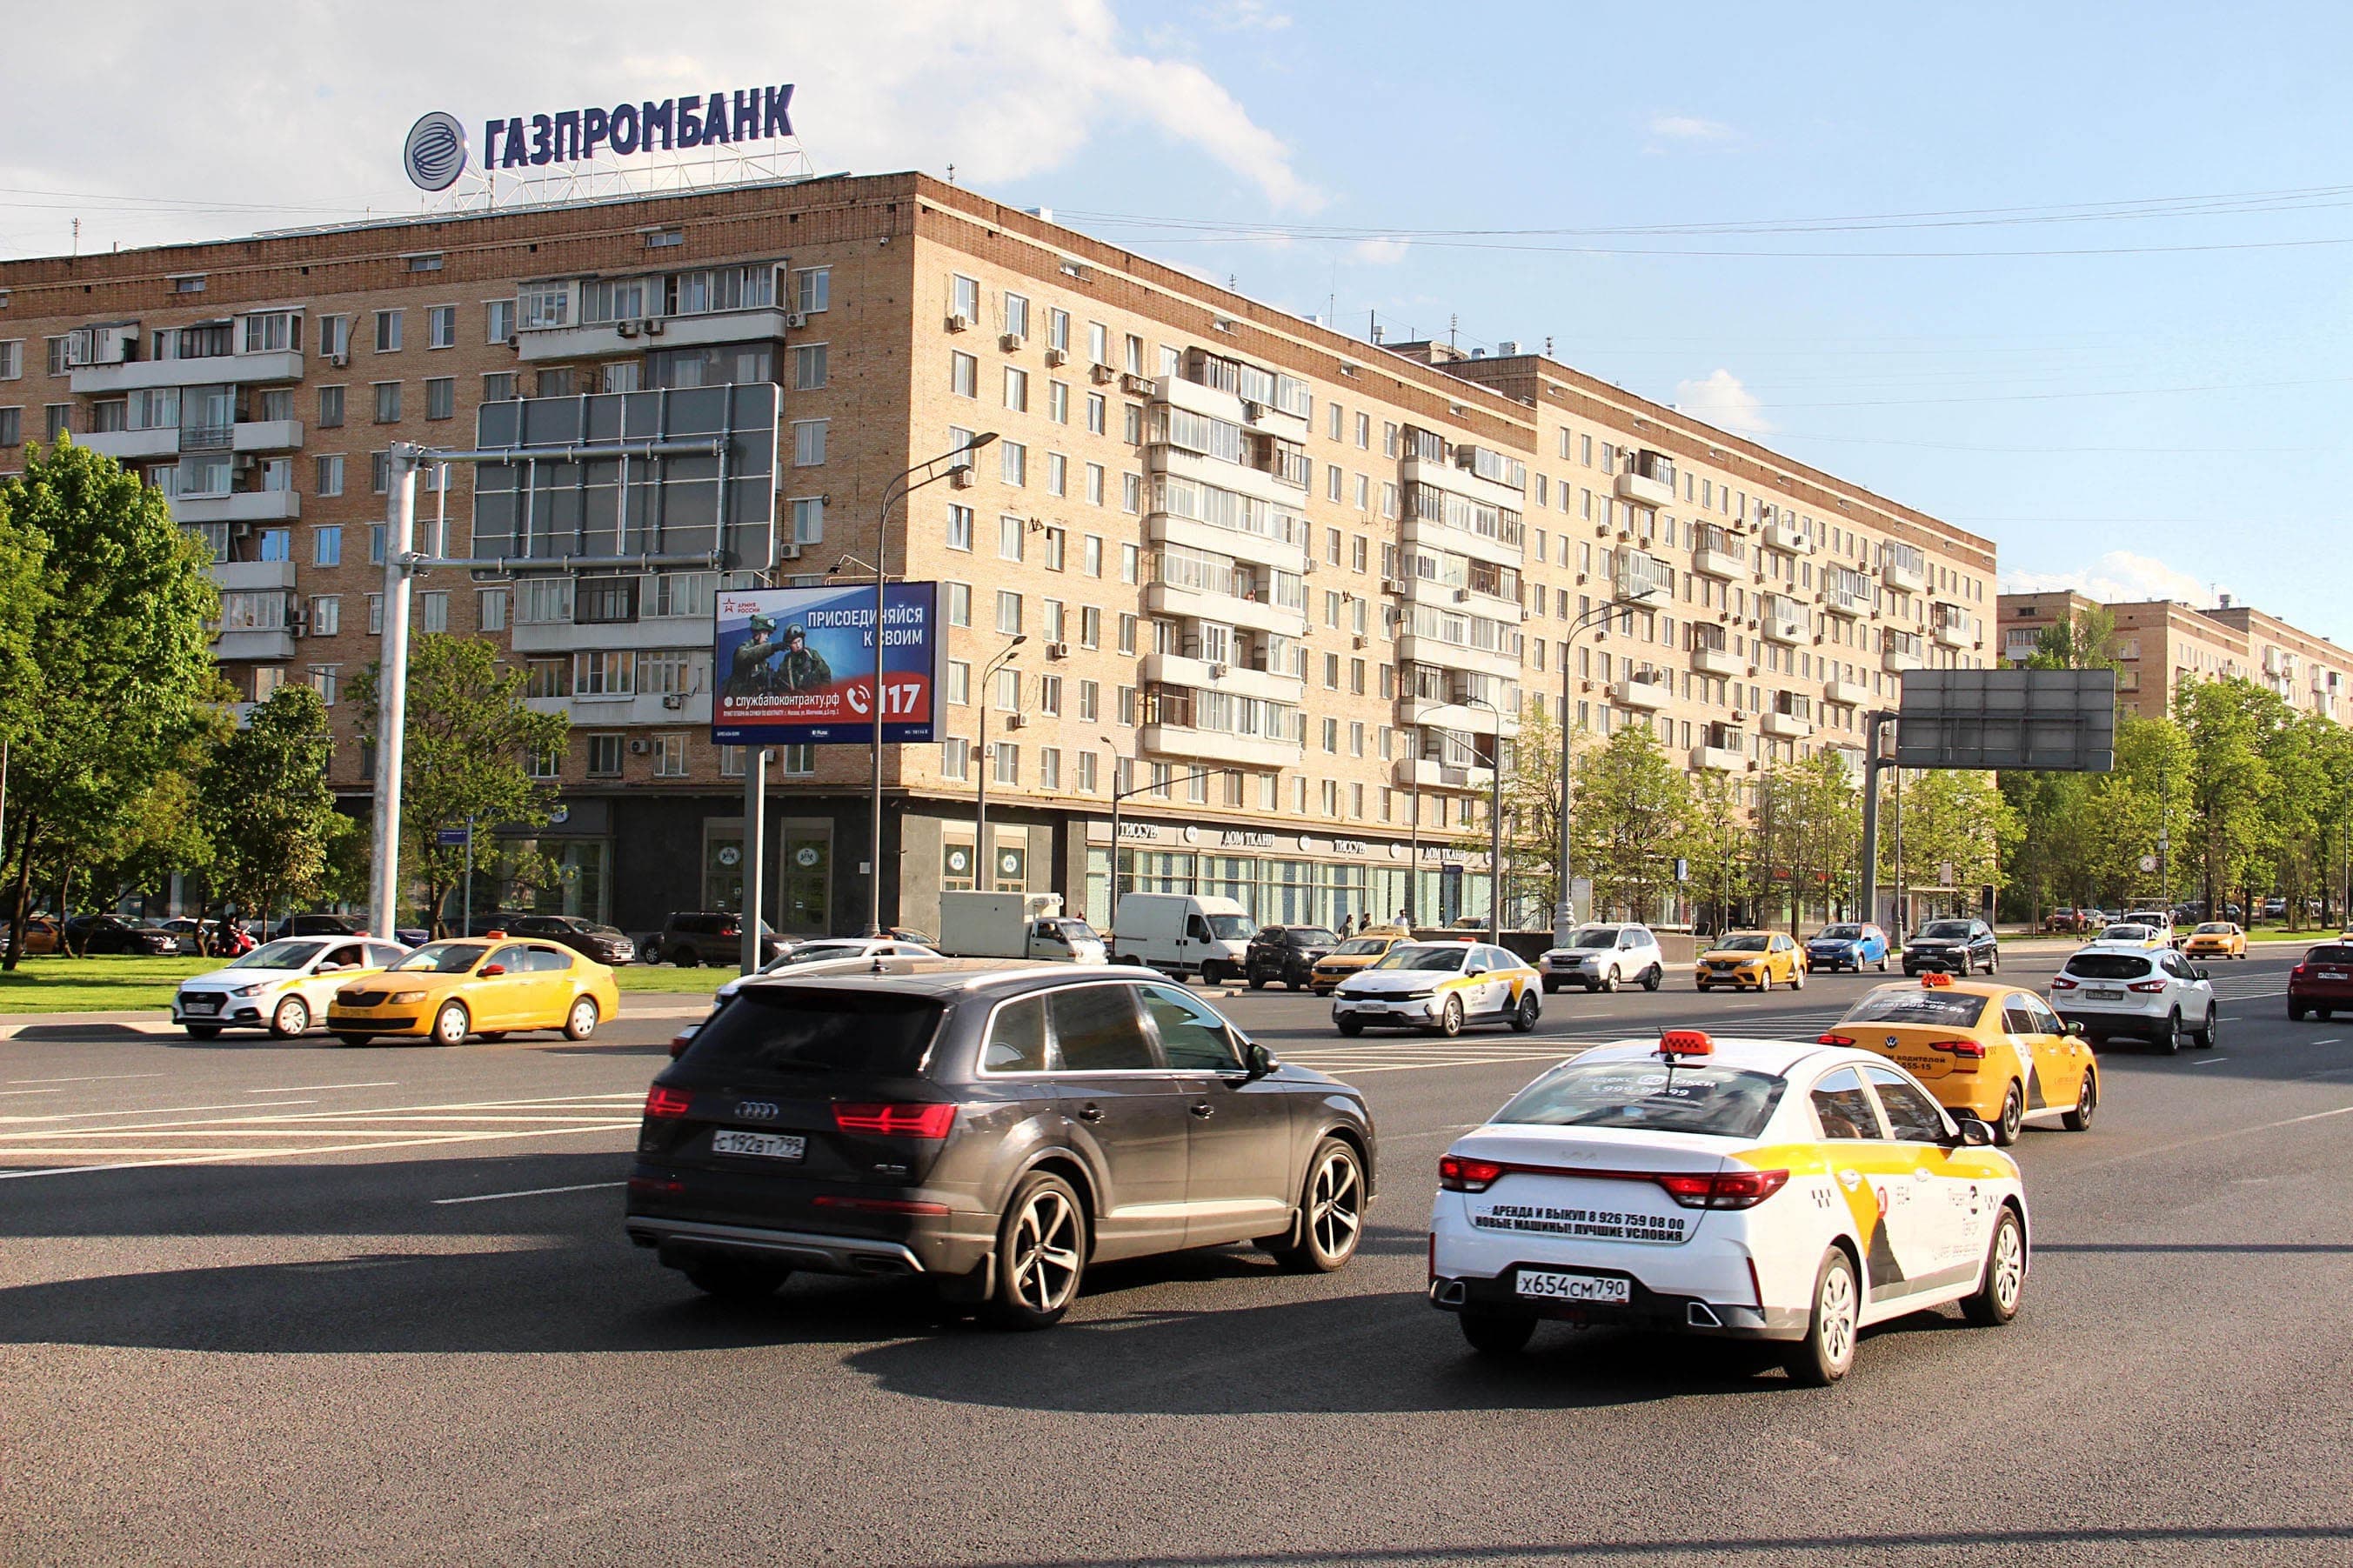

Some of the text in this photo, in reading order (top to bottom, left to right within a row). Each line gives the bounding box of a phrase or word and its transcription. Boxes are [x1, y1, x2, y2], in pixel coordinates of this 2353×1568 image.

[485, 83, 795, 170] ГАЗПРОМБАНК
[807, 604, 923, 628] ПРИСОЕДИНЯЙСЯ
[864, 631, 873, 646] К
[736, 692, 839, 710] службапоконтракту.рф
[1120, 822, 1159, 838] ТИССУРА
[1222, 831, 1275, 847] ДОМ ТКАНИ
[1334, 839, 1367, 854] ТИССУРА
[1424, 847, 1441, 861] ДОМ
[1492, 1205, 1684, 1230] АРЕНДА И ВЫКУП 8 926 759 08 00
[1475, 1216, 1682, 1241] НОВЫЕ МАШИНЫ! ЛУЧШИЕ УСЛОВИЯ
[1522, 1274, 1625, 1298] Х654СМ 790
